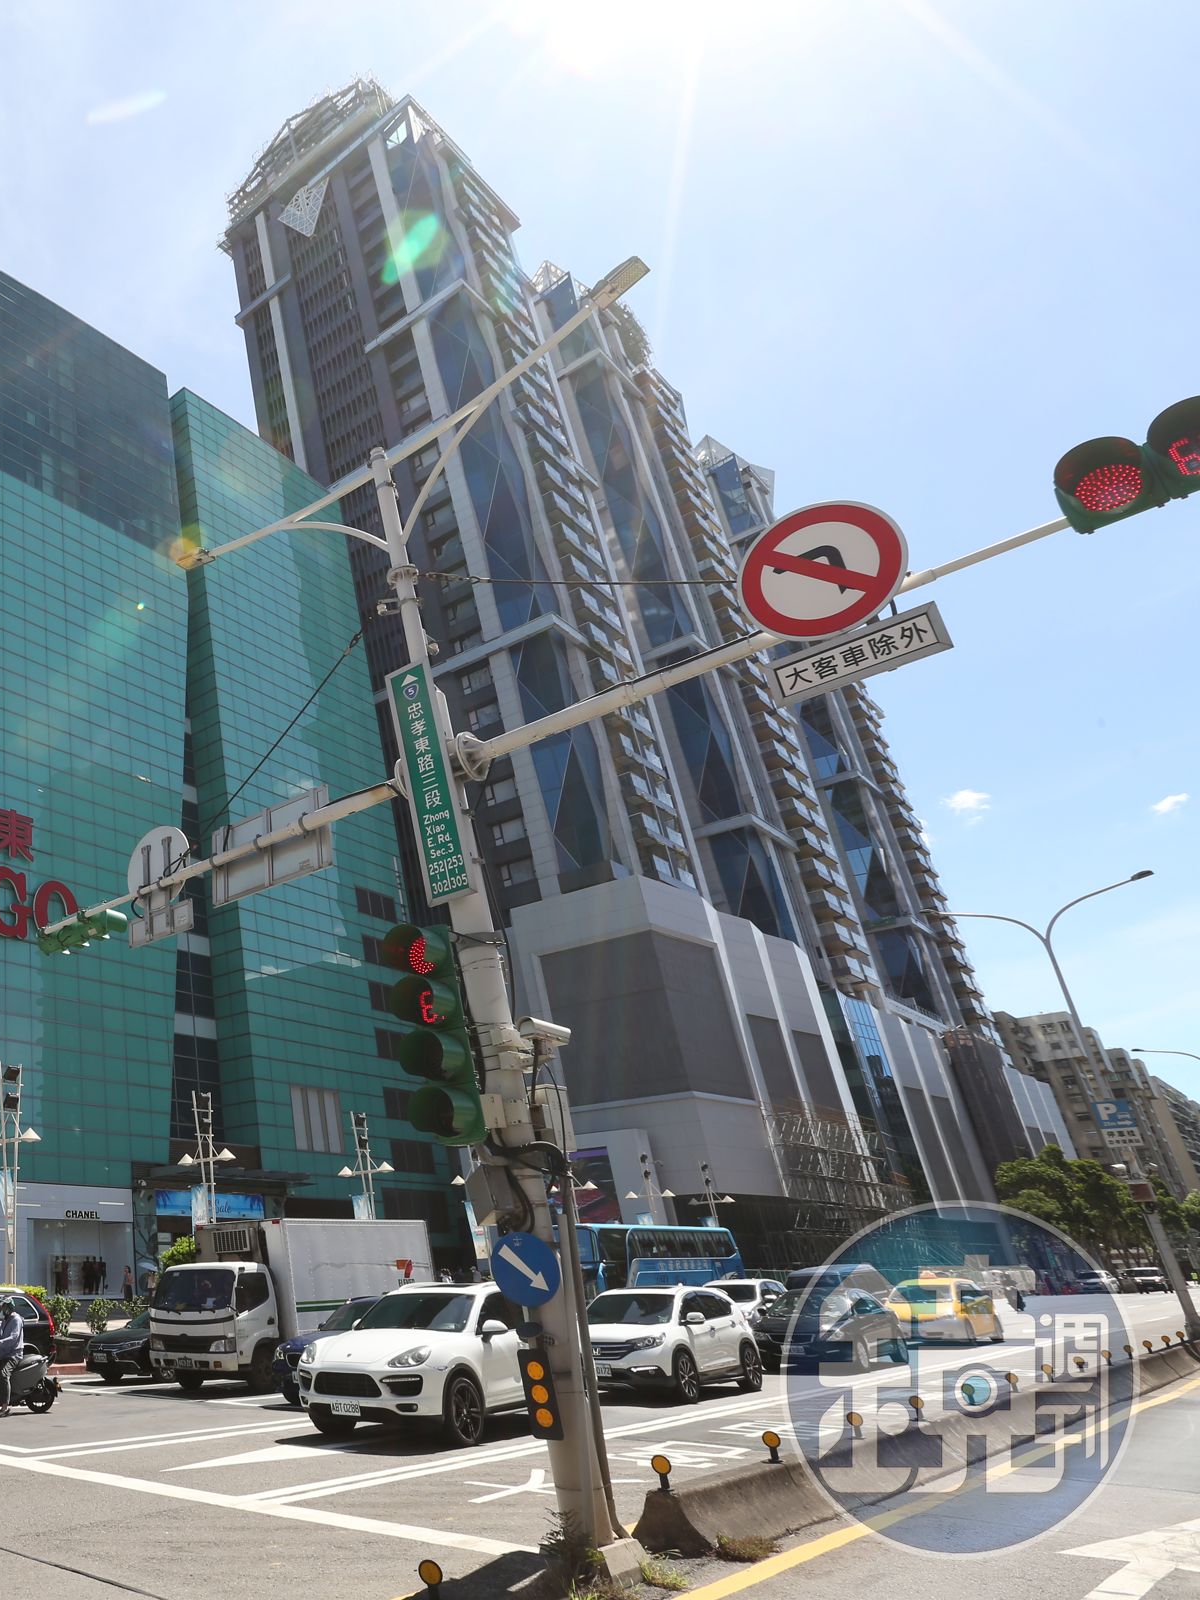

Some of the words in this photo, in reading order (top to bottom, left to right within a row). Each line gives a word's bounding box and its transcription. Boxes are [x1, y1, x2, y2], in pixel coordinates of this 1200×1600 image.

[784, 621, 928, 691] 大客車除外
[408, 687, 415, 696] 5
[407, 701, 442, 810] 忠孝東路三段
[422, 809, 450, 825] Zhong
[425, 823, 446, 836] Xiao
[427, 837, 437, 848] E.
[437, 832, 452, 843] Rd.
[430, 843, 454, 859] Sec.3
[428, 860, 445, 876] 252
[447, 854, 464, 870] 253
[432, 879, 450, 895] 302
[451, 873, 468, 890] 305
[1096, 1103, 1117, 1121] P
[65, 1209, 100, 1219] CHANEL
